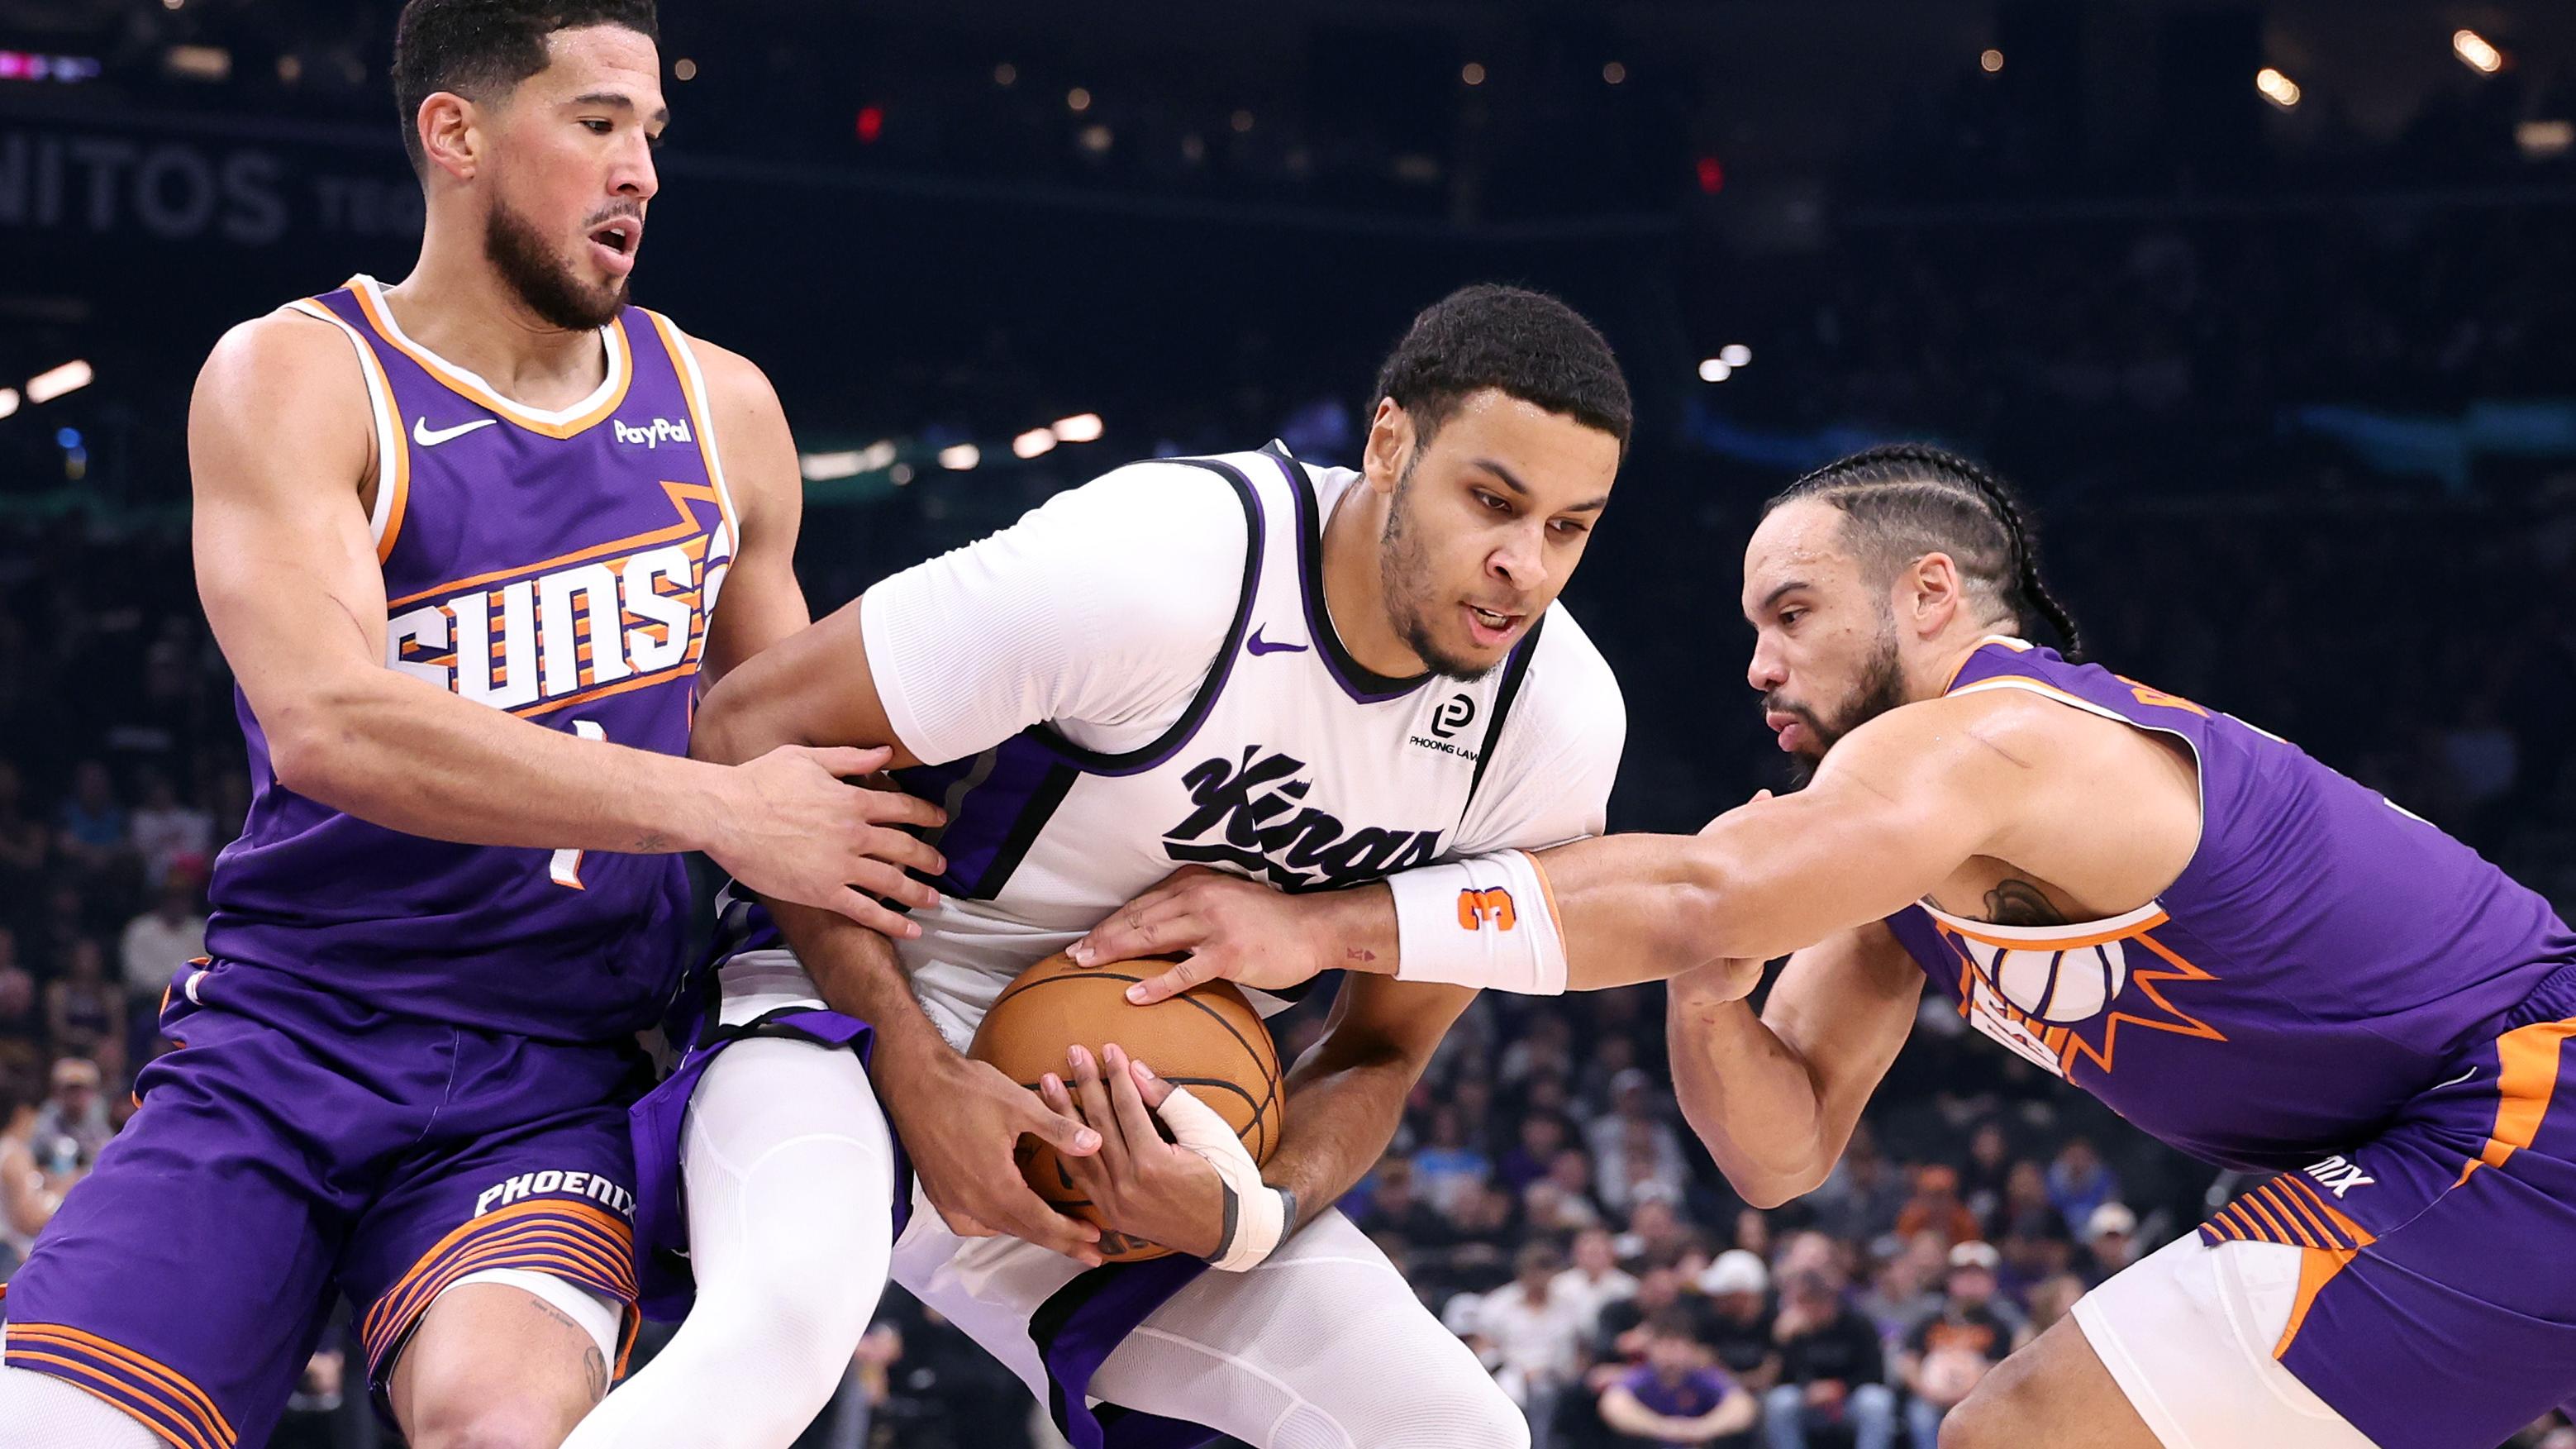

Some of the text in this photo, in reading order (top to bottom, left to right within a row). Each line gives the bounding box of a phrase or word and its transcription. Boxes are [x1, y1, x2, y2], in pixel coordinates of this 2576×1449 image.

[613, 418, 693, 449] PayPal
[386, 546, 693, 710] SUNS
[1409, 736, 1455, 754] PHOONG
[474, 1170, 636, 1225] PHOENIX
